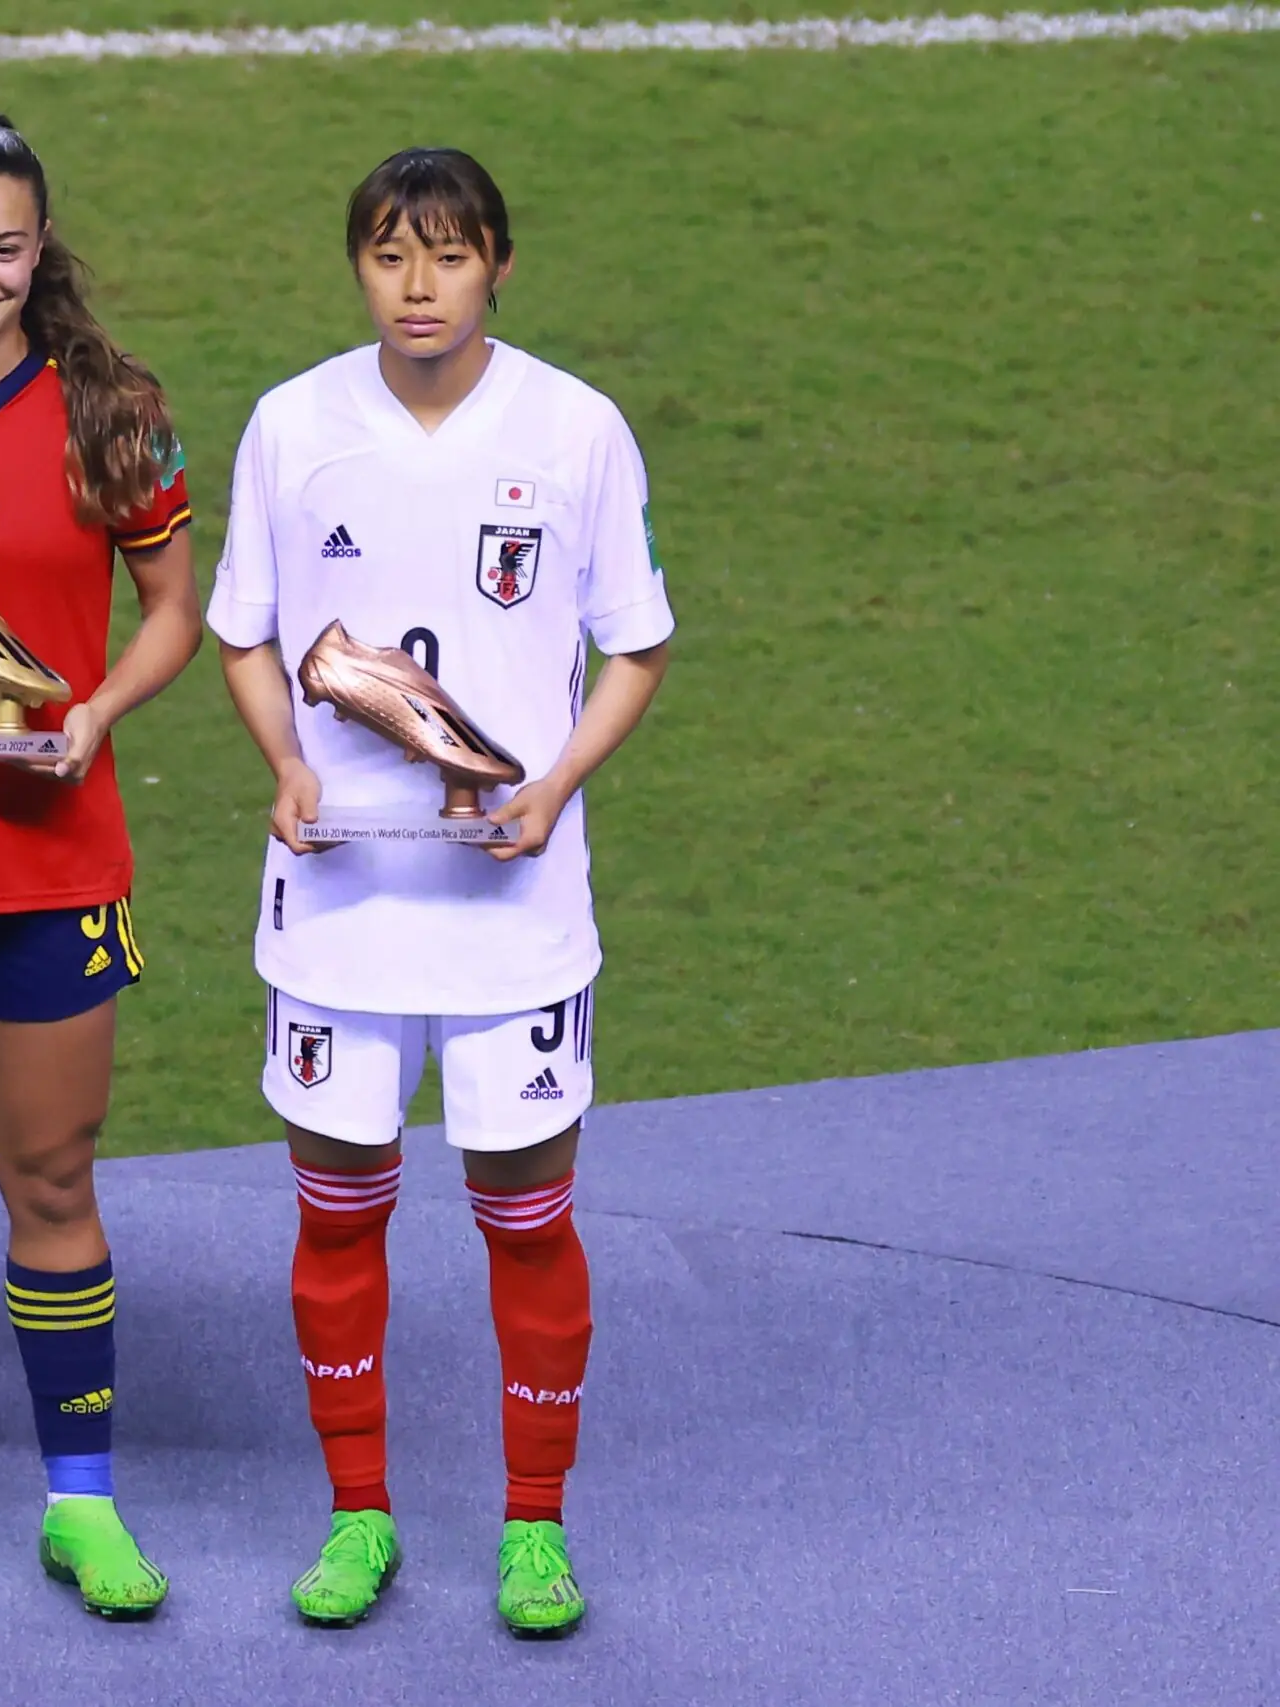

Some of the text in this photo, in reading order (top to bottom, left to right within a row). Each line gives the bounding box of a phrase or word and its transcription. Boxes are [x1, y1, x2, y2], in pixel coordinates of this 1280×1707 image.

[495, 527, 530, 536] JAPAN
[321, 546, 361, 558] adidas
[304, 827, 320, 838] FIFA
[321, 828, 340, 838] U-20
[378, 829, 401, 839] World
[402, 829, 418, 840] Cup
[419, 829, 441, 839] Costa
[442, 829, 458, 839] Rica
[520, 1087, 564, 1100] adidas
